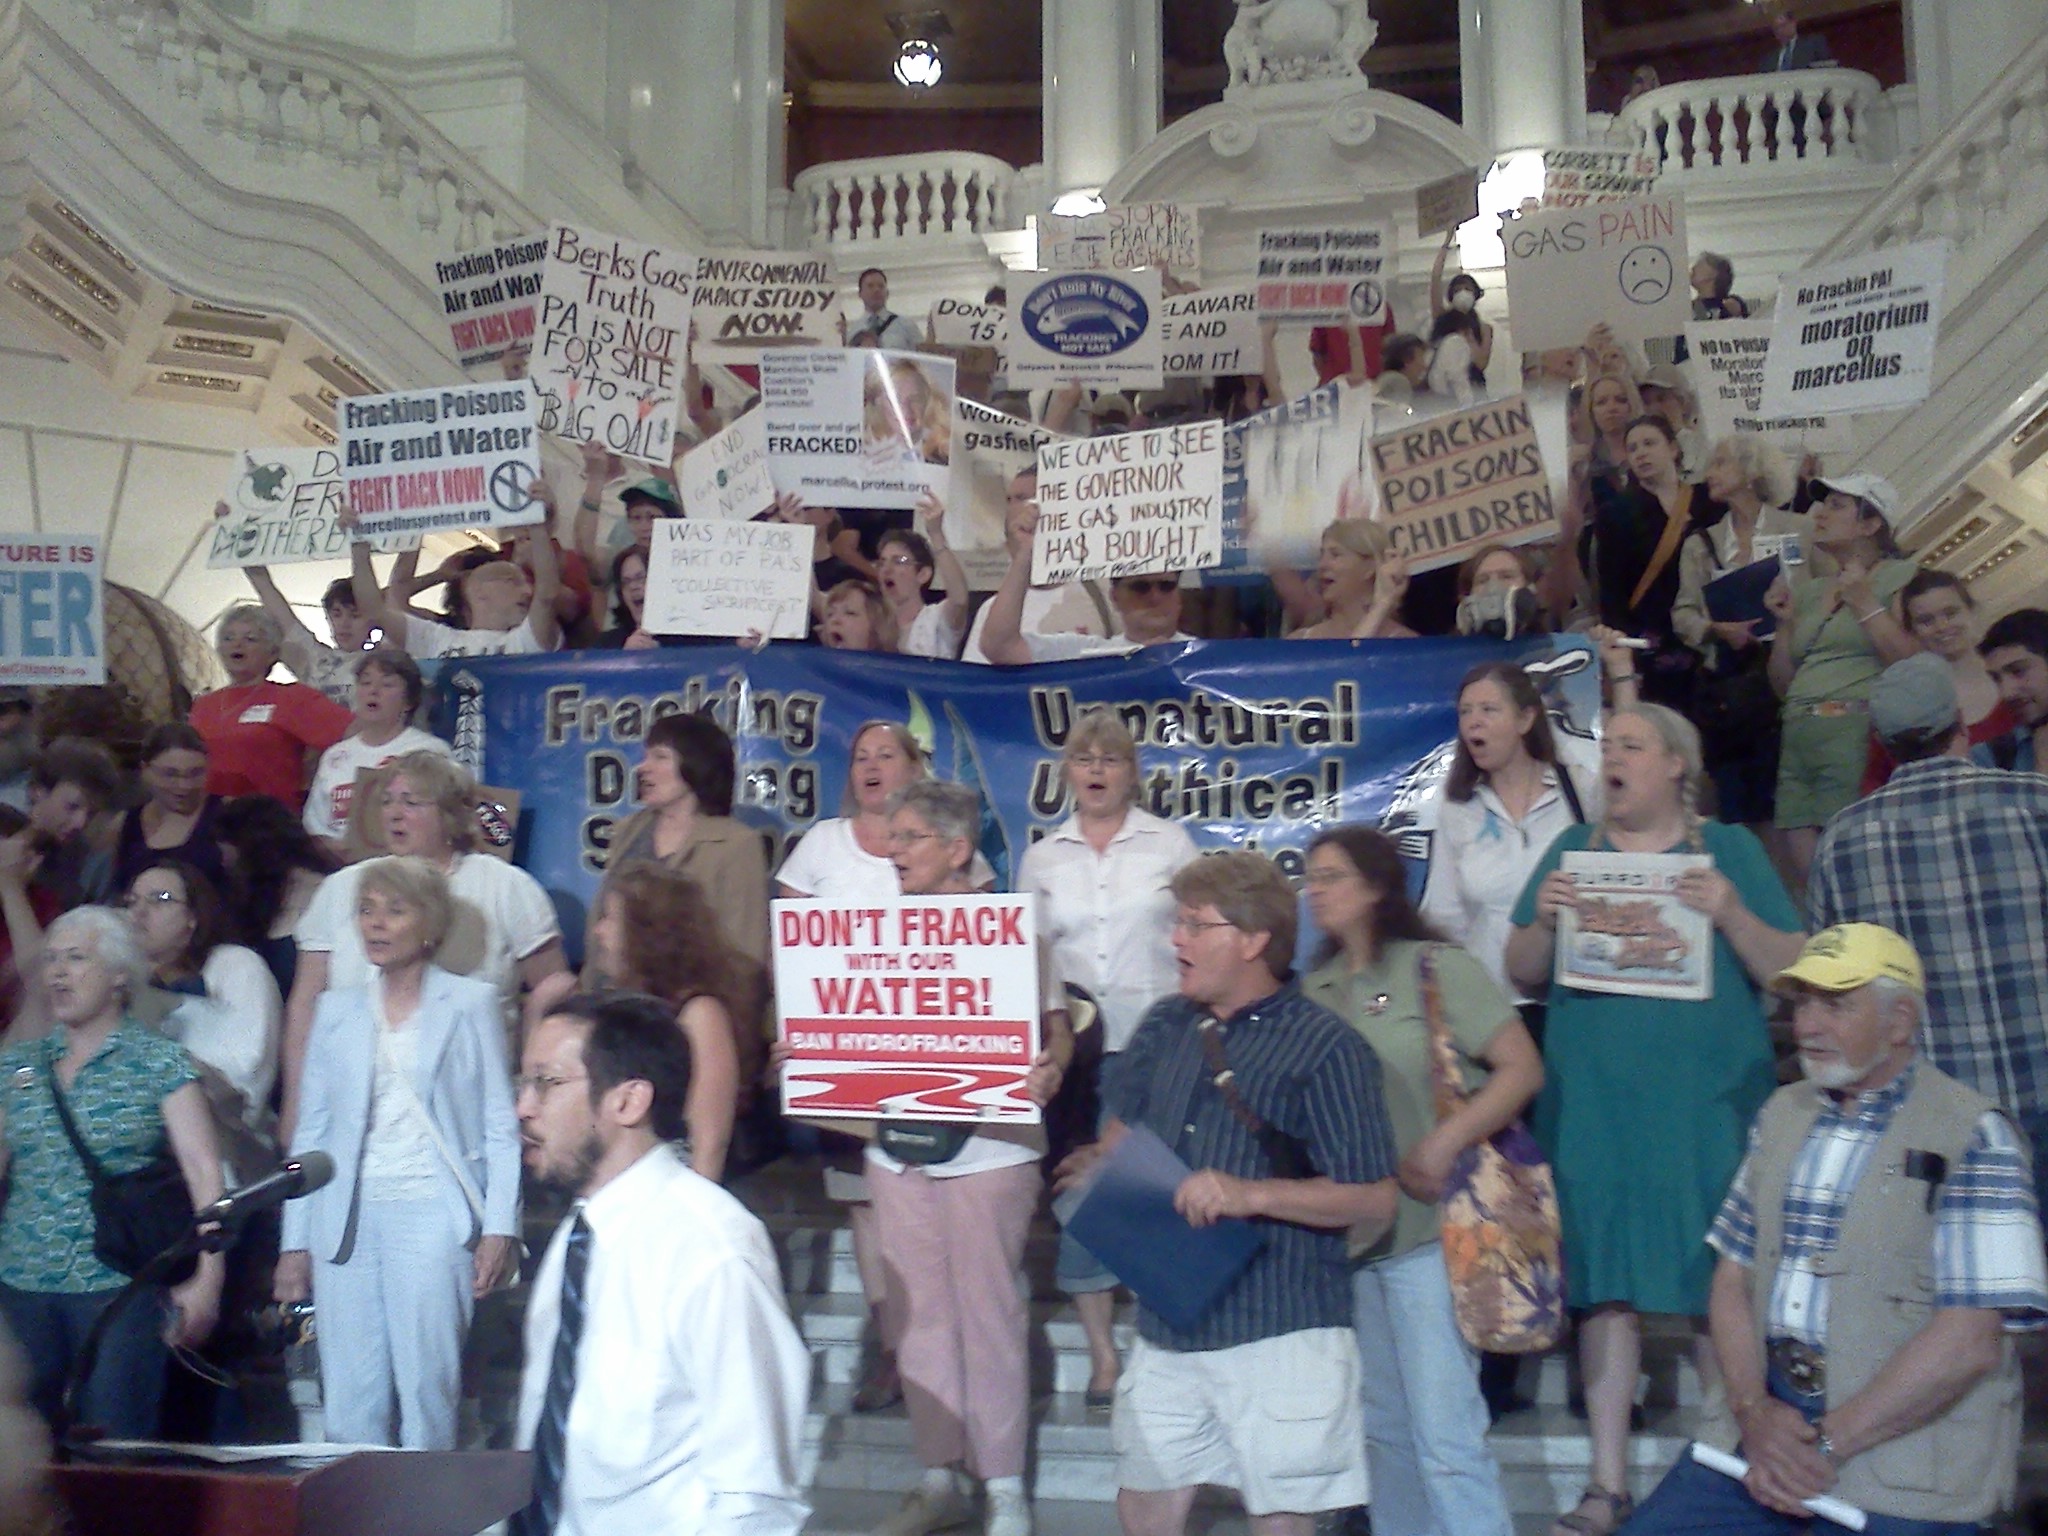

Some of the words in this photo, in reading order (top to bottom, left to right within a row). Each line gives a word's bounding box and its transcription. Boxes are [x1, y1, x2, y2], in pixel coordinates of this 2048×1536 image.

[1512, 221, 1586, 259] GAS
[1597, 199, 1674, 246] PAIN
[436, 253, 495, 284] Fracking
[552, 227, 636, 280] Berks
[642, 249, 692, 295] Gas
[443, 289, 468, 314] Air
[470, 280, 505, 307] and
[505, 272, 544, 299] Wat
[580, 270, 655, 320] Truth
[692, 286, 753, 307] IMPACT
[753, 287, 836, 312] STUDY
[1817, 277, 1867, 302] Frackin
[542, 294, 578, 334] PA
[622, 318, 680, 358] NOT
[1179, 321, 1227, 340] AND
[1801, 300, 1930, 345] moratorium
[544, 329, 600, 369] FOR
[611, 348, 675, 390] SALE
[1212, 348, 1239, 370] IT!
[1846, 334, 1874, 359] on
[583, 370, 618, 400] to
[1792, 353, 1902, 391] marcellus
[345, 396, 437, 429] Fracking
[441, 390, 526, 419] Poisons
[346, 438, 384, 467] Air
[390, 431, 443, 462] and
[447, 426, 533, 456] Water
[768, 436, 863, 455] FRACKED!
[964, 430, 1048, 451] gasfiel
[1041, 445, 1071, 471] WE
[1076, 436, 1131, 467] CAME
[1142, 433, 1162, 458] TO
[1168, 425, 1217, 460] $EE
[1372, 403, 1533, 473] FRACKIN
[348, 475, 393, 515] FIGHT
[397, 470, 441, 511] BACK
[442, 466, 486, 504] NOW!
[1039, 482, 1069, 503] THE
[1076, 461, 1185, 502] GOVERNOR
[1381, 443, 1540, 513] POISONS
[669, 523, 714, 543] WAS
[725, 526, 759, 546] MY
[1038, 512, 1071, 534] THE
[1078, 503, 1120, 529] GA$
[1388, 485, 1556, 553] CHILDREN
[0, 545, 60, 563] URE
[69, 545, 95, 563] IS
[720, 550, 747, 567] OF
[1045, 532, 1090, 566] HA$
[1105, 525, 1205, 562] BOUGHT
[1030, 758, 1344, 822] Uthical
[779, 908, 888, 948] DON'T
[899, 905, 1027, 947] FRACK
[845, 952, 902, 971] WITH
[908, 952, 957, 971] OUR
[811, 976, 993, 1017] WATER!
[790, 1031, 834, 1050] BAN
[836, 1032, 1025, 1055] HYDROFRACKING
